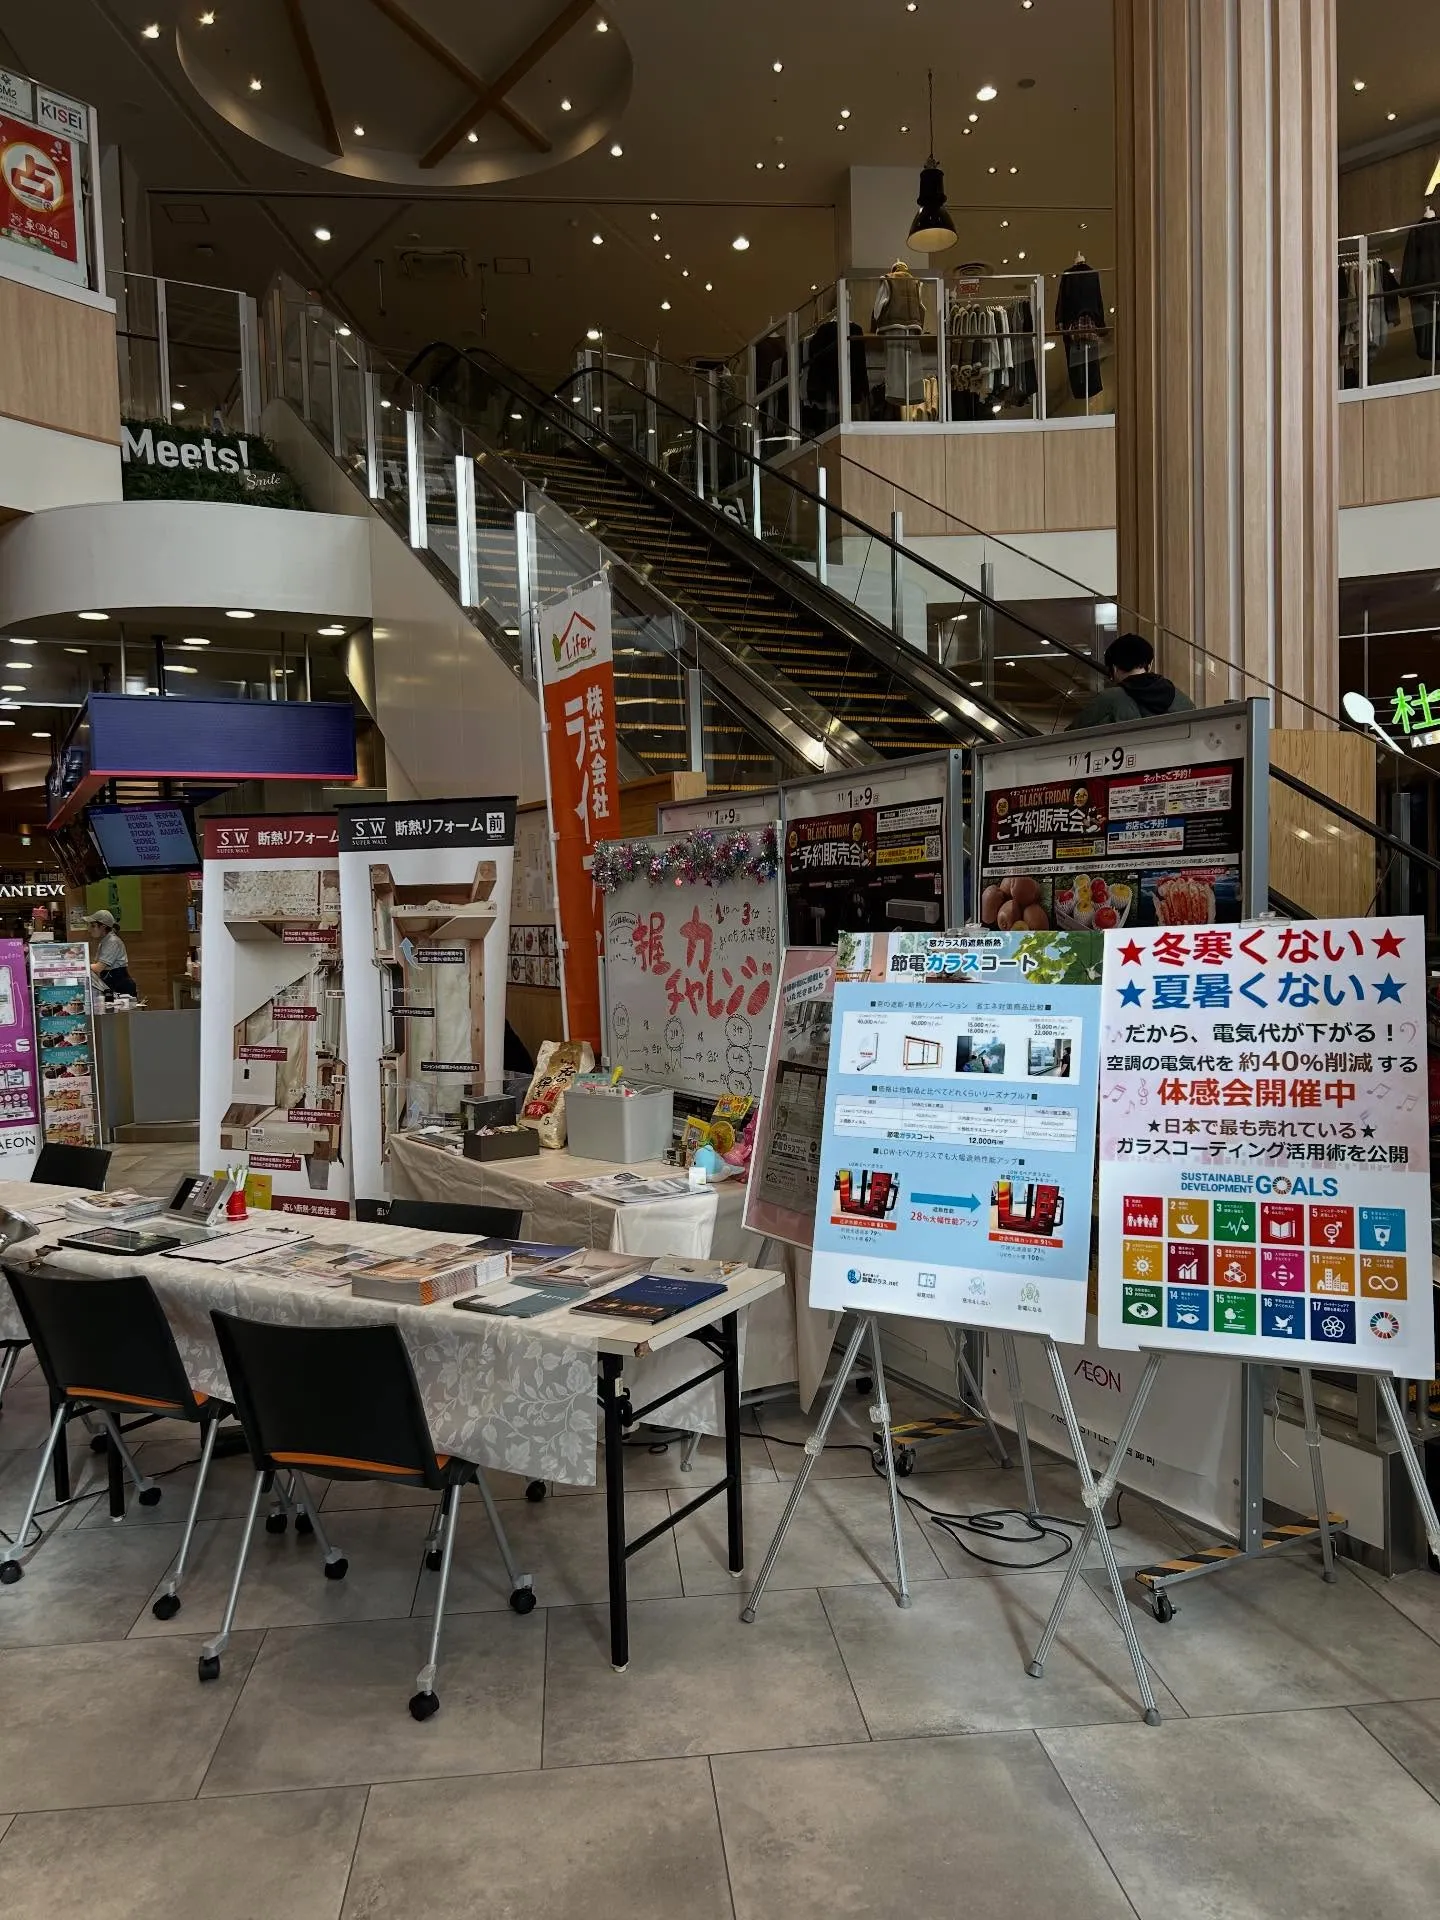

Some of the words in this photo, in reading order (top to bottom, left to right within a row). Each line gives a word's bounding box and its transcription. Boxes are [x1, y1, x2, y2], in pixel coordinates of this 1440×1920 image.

[41, 101, 82, 130] KISEI
[120, 425, 251, 476] Meets!
[246, 472, 281, 490] Smile
[565, 633, 592, 662] Lifer
[586, 684, 610, 820] 株式会社
[1019, 790, 1044, 808] BLACK
[1044, 788, 1072, 805] FRIDAY
[395, 817, 484, 836] 断熱リフォーム
[488, 815, 503, 832] 前
[996, 807, 1086, 841] ご予約販売会
[257, 829, 339, 846] 断熱リフォーム
[807, 826, 828, 841] BLACK
[828, 823, 850, 839] FRIDAY
[371, 838, 388, 846] WALL
[790, 841, 862, 872] ご予約販売会
[928, 938, 1002, 948] 窓ガラス用遮熱断熱
[1151, 928, 1365, 967] 冬寒くない
[890, 953, 1037, 972] 節電ガラスコート
[1151, 970, 1365, 1010] 夏暑くない
[1106, 1054, 1233, 1072] 空調の電気代を
[1377, 1055, 1418, 1073] する
[1156, 1077, 1356, 1109] 体感会開催中
[1164, 1117, 1357, 1139] 日本で最も売れている
[887, 1130, 935, 1140] 節電ガラスコート
[1116, 1137, 1409, 1164] ガラスコーティング活用術を公開
[1181, 1171, 1254, 1183] SUSTAINABLE
[1181, 1182, 1254, 1194] DEVELOPMENT
[1255, 1175, 1338, 1197] GOALS
[1124, 1198, 1130, 1207] 1
[1169, 1201, 1176, 1210] 2
[1216, 1203, 1222, 1213] 3
[1263, 1205, 1270, 1215] 4
[1311, 1208, 1318, 1217] 5
[1362, 1210, 1369, 1220] 6
[910, 1211, 979, 1228] 28%大幅性能アップ
[1125, 1242, 1131, 1251] 7
[1170, 1245, 1176, 1255] 8
[1216, 1248, 1222, 1258] 9
[1263, 1251, 1273, 1261] 10
[1311, 1254, 1320, 1264] 11
[1362, 1258, 1372, 1267] 12
[1124, 1286, 1134, 1296] 13
[1169, 1290, 1179, 1299] 14
[1215, 1294, 1225, 1304] 15
[1263, 1298, 1273, 1308] 16
[1312, 1301, 1321, 1311] 17
